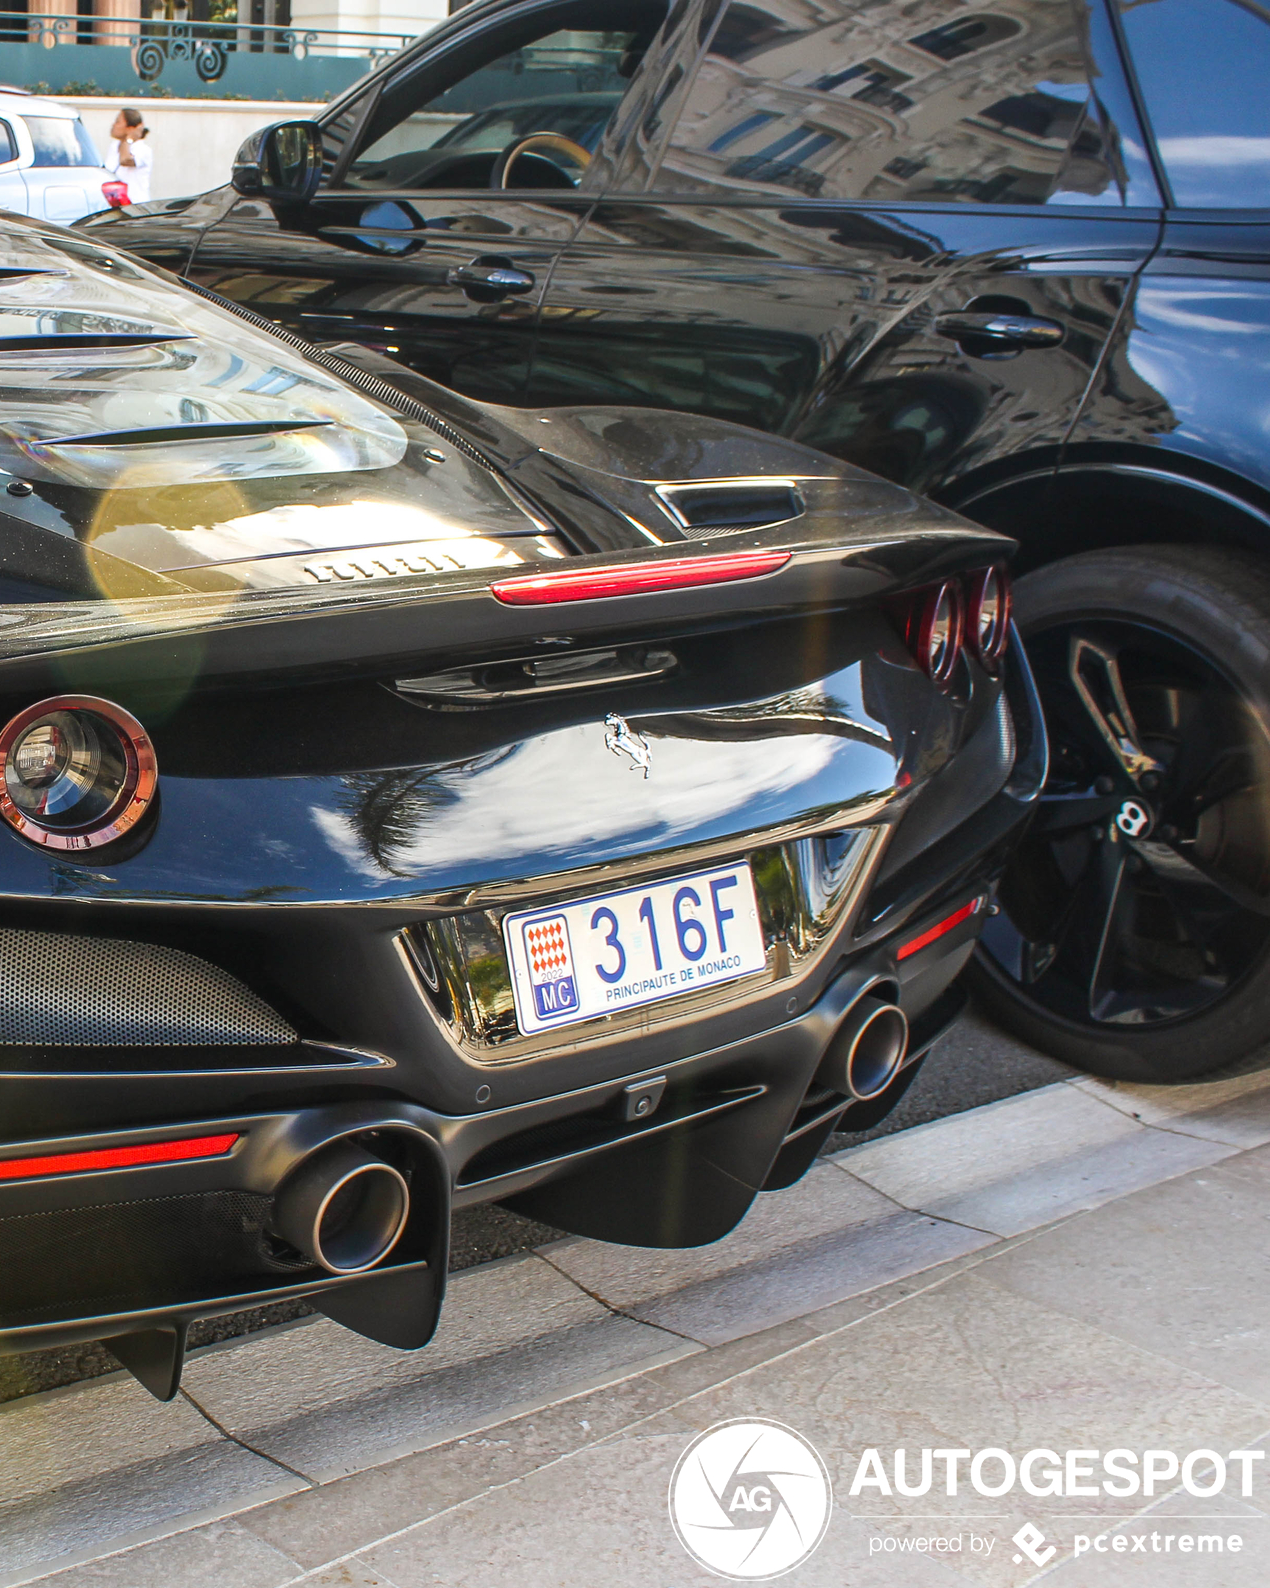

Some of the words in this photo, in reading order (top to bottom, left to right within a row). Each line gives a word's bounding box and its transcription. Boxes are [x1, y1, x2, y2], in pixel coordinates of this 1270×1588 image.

[591, 874, 738, 984] 316F
[541, 968, 564, 983] 2022
[606, 973, 677, 1002] PRINCIPAUTE
[680, 968, 695, 982] DE
[698, 955, 742, 977] MONACO
[541, 981, 572, 1011] MC
